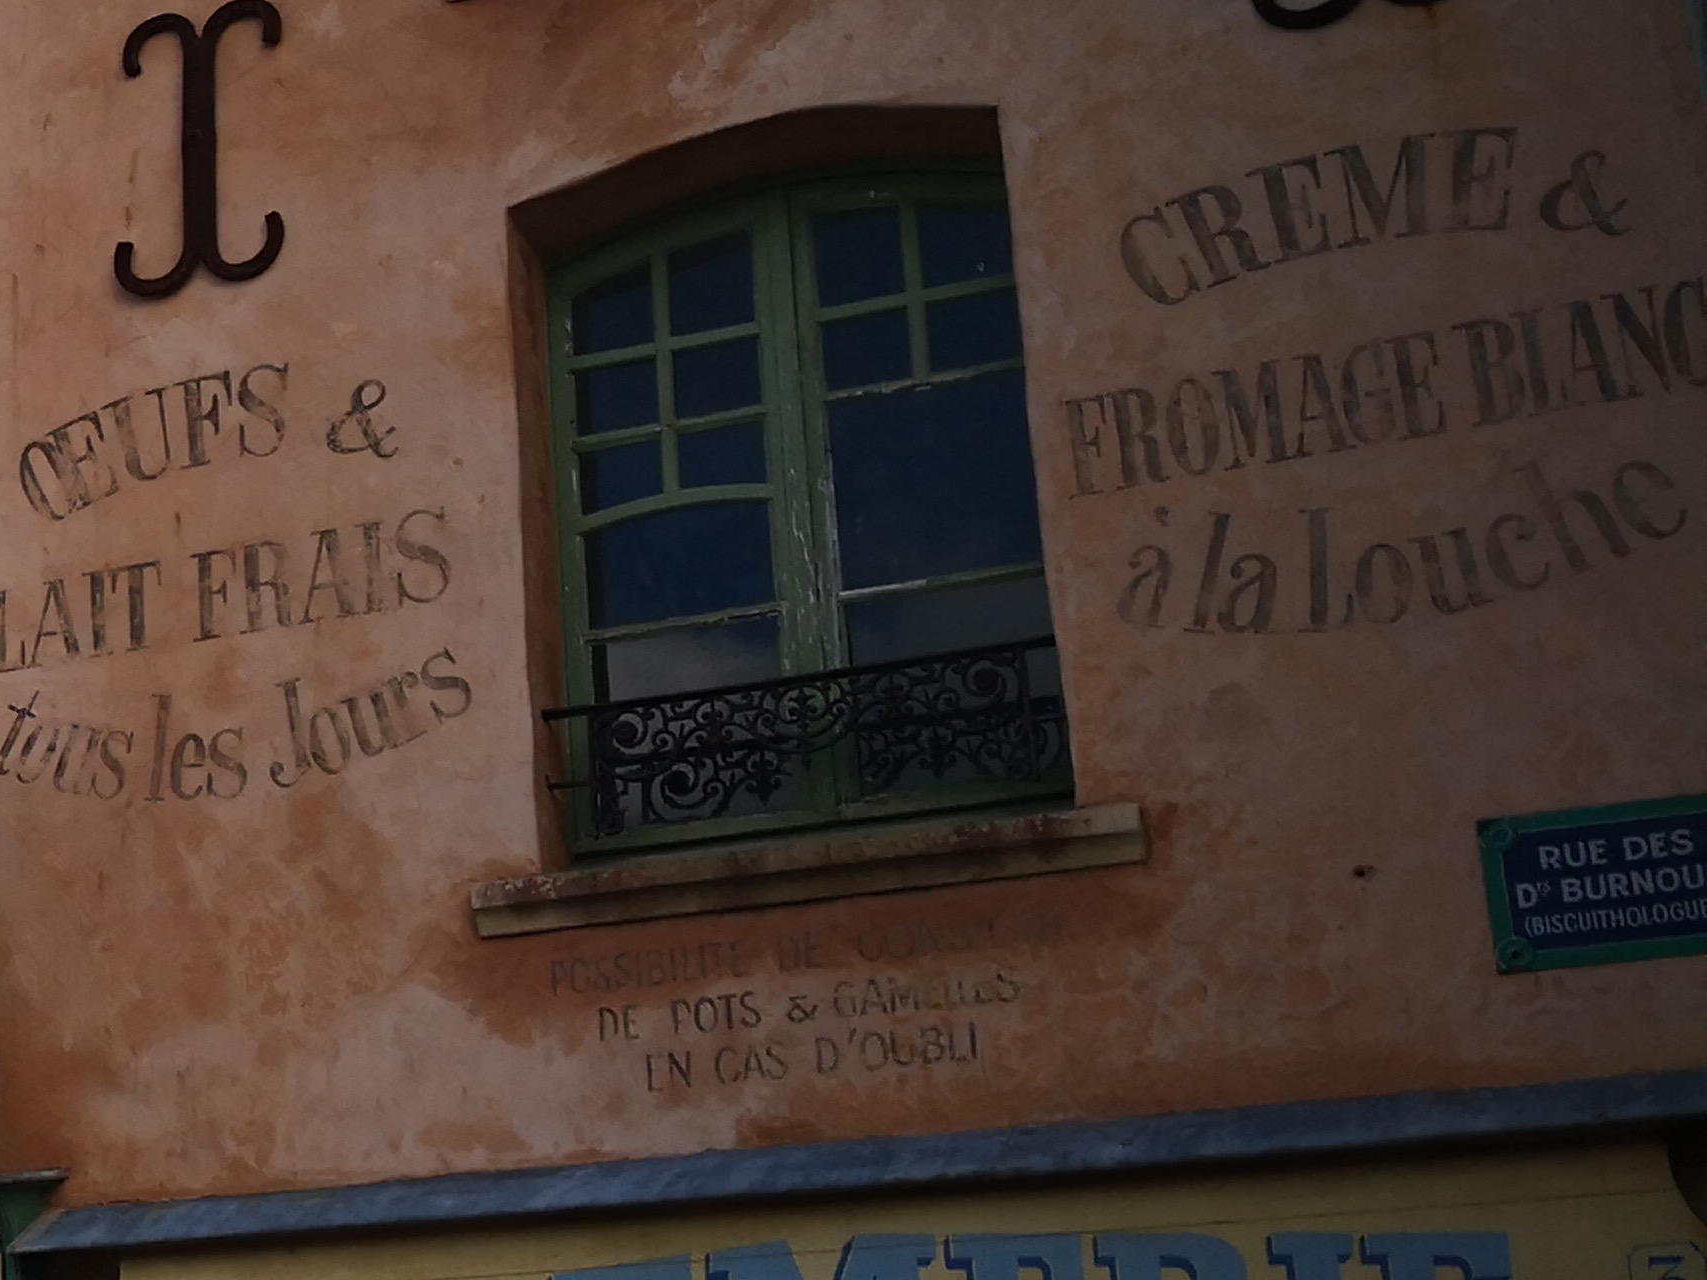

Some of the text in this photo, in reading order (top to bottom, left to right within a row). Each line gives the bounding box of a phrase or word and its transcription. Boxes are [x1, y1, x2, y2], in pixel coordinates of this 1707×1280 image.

[1119, 125, 1632, 307] CREME &
[325, 378, 400, 459] &
[1064, 274, 1707, 501] FROMAGE BLANC
[189, 508, 452, 644] FRAIS
[143, 692, 249, 803] les
[269, 646, 473, 789] Jours
[1538, 828, 1695, 870] RUE DES
[597, 1004, 640, 1044] DE
[672, 990, 764, 1036] POTS
[645, 1051, 693, 1093] EN
[714, 1045, 788, 1087] CAS
